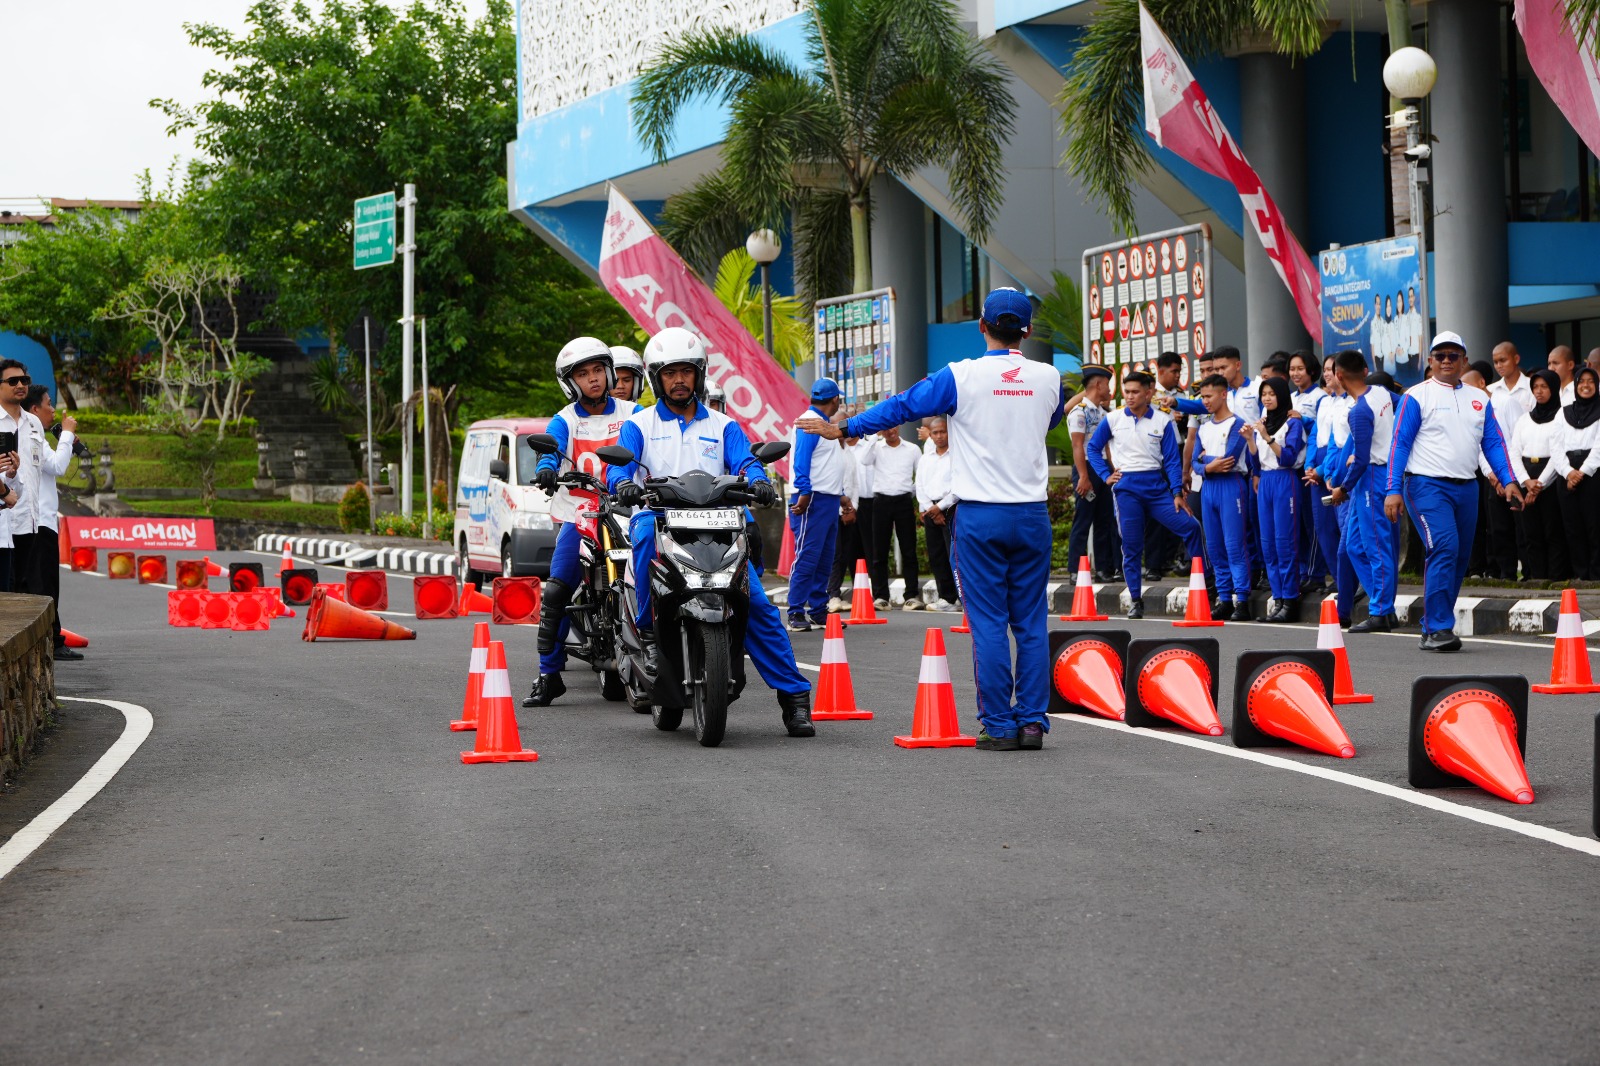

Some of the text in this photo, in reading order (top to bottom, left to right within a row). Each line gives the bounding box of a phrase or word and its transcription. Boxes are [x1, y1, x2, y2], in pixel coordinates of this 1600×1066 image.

[1324, 280, 1370, 296] BANGUN INTEGRITAS
[1332, 304, 1363, 322] SENYUM
[993, 389, 1034, 397] INSTRUKTUR
[670, 511, 737, 519] DK 6641 AFB
